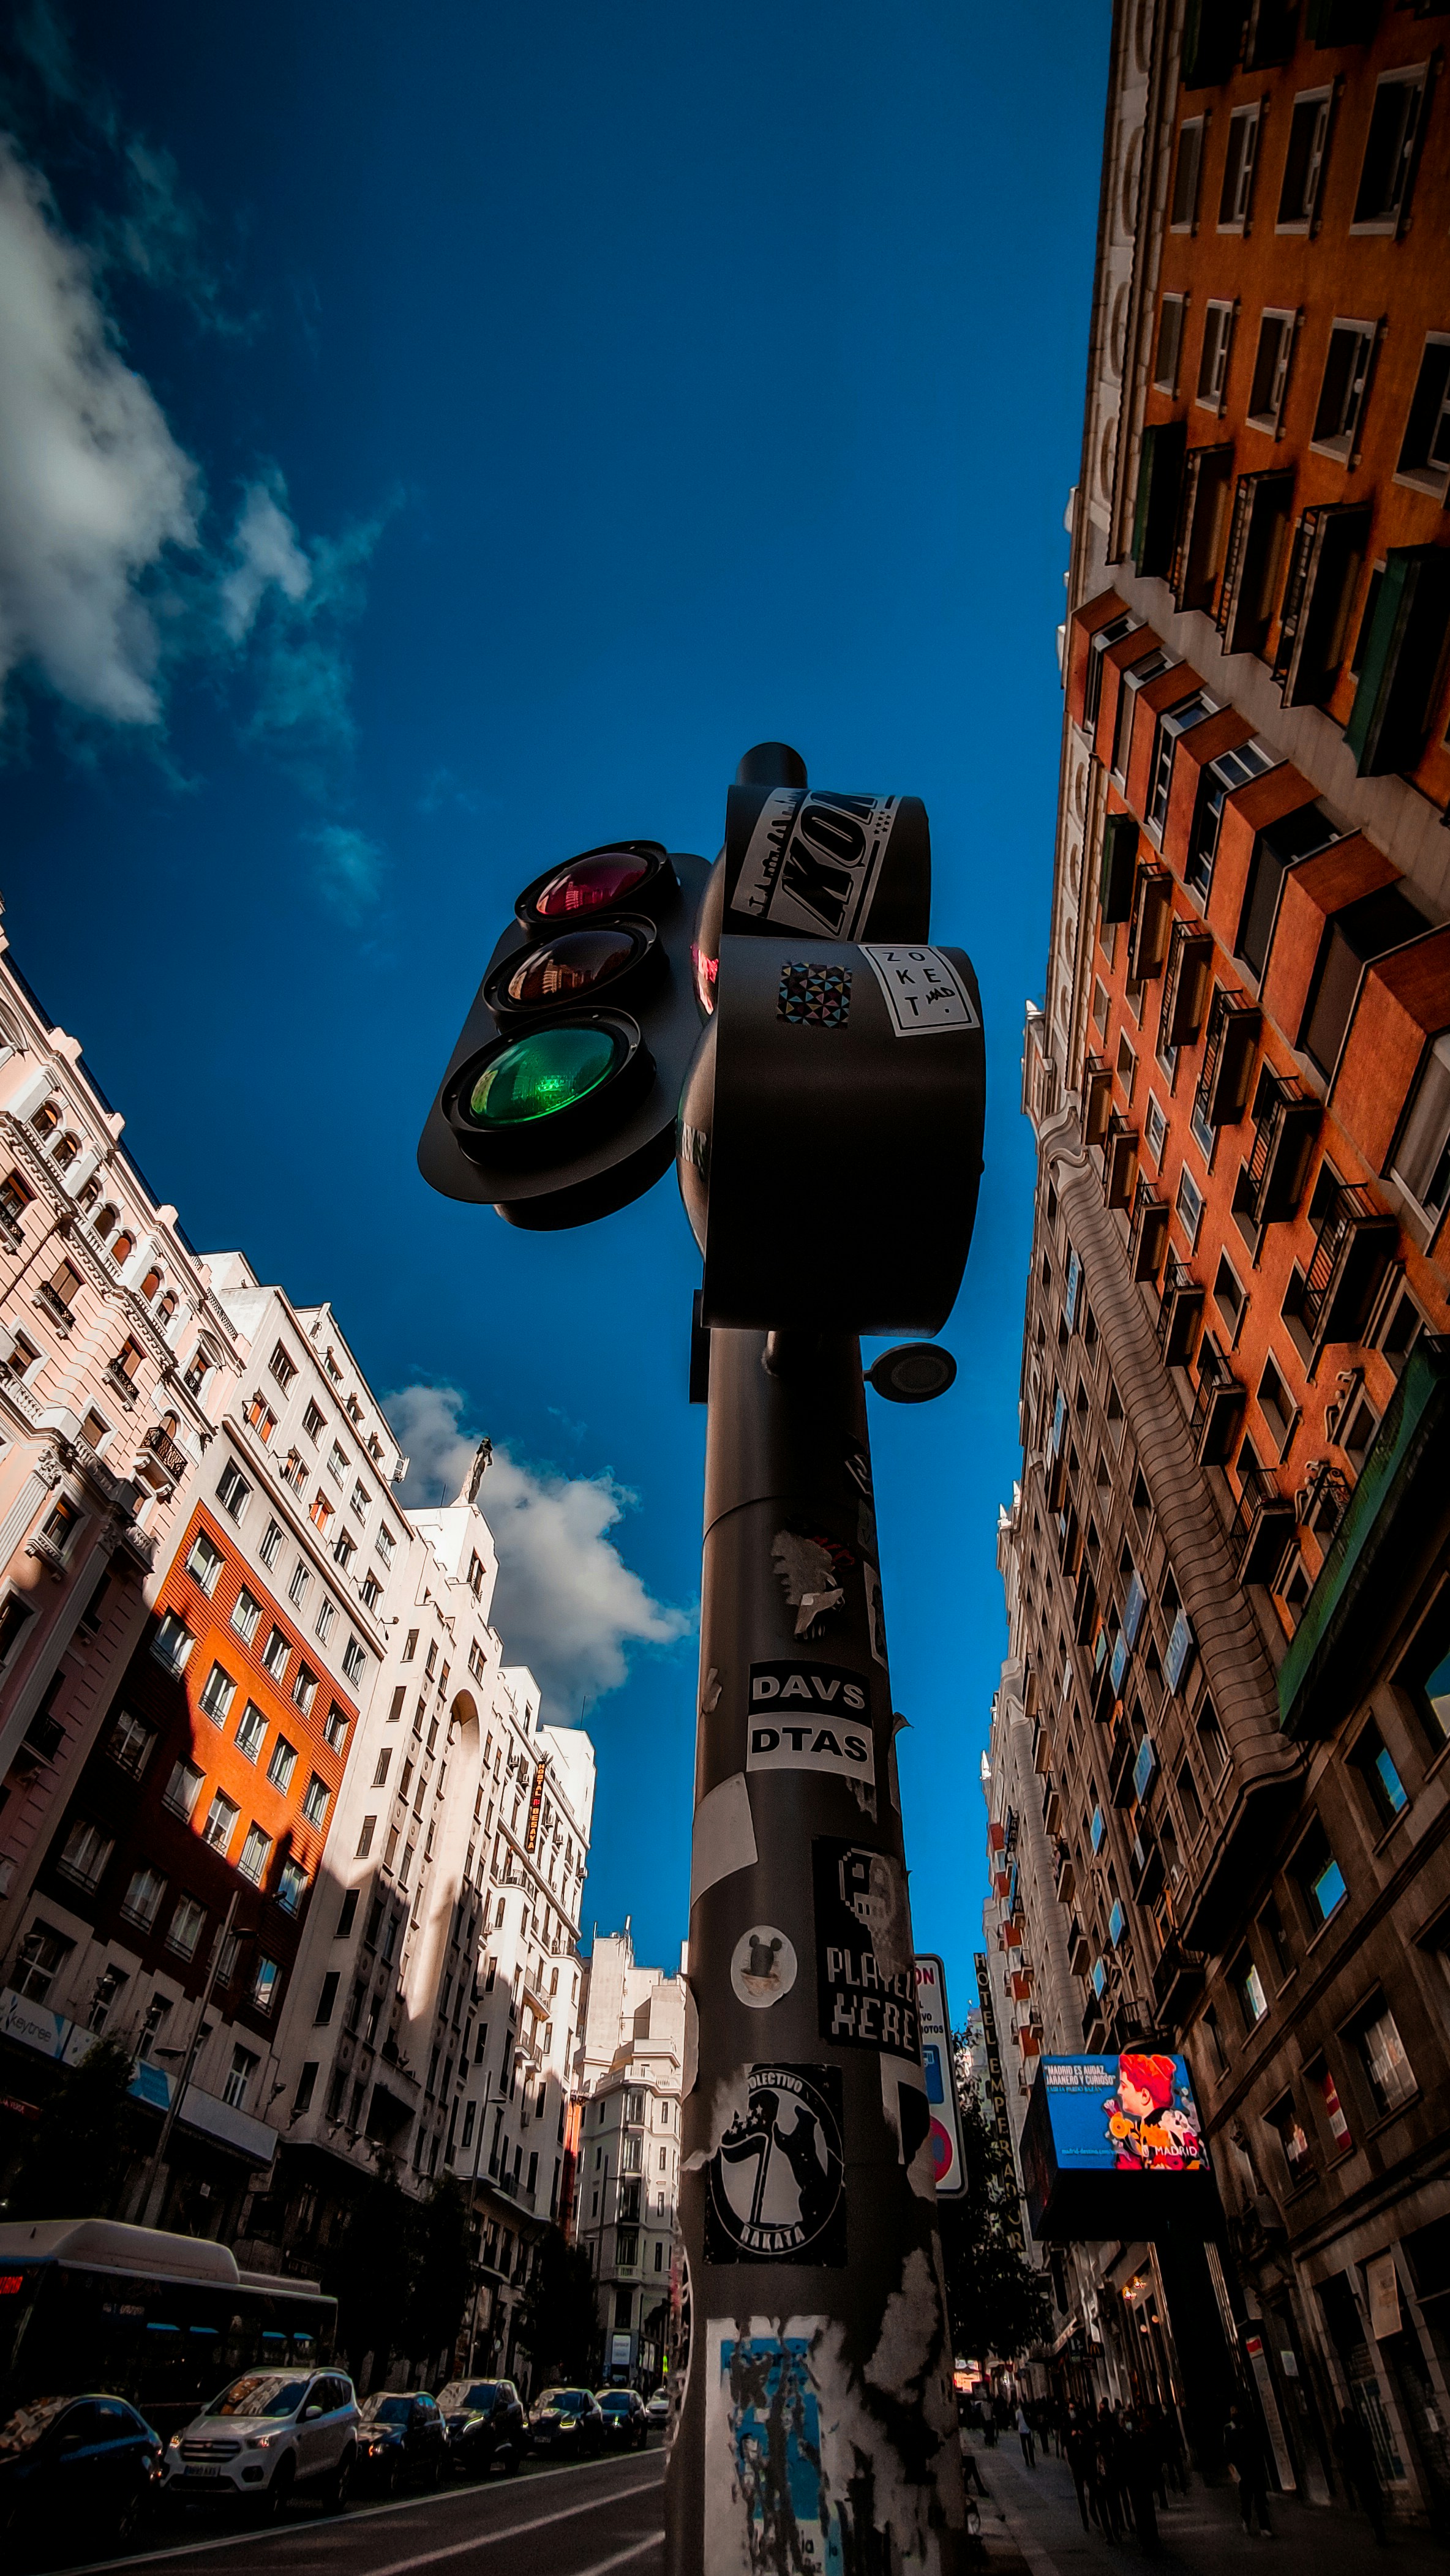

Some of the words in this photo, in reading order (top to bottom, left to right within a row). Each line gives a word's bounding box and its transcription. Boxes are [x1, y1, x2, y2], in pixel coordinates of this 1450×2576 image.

[753, 1675, 866, 1710] DAVS
[751, 1726, 868, 1763] DTAS
[10, 2010, 52, 2043] keytree
[831, 1992, 915, 2052] HERE
[748, 2072, 803, 2094] OLECTIVO
[1073, 2065, 1083, 2075] ES
[1083, 2065, 1107, 2076] AUDAZ,
[1079, 2075, 1084, 2086] Y
[974, 1953, 997, 2046] HOTEL
[989, 2057, 1026, 2252] EMPERADOR
[1154, 2145, 1198, 2159] MADRID
[740, 2224, 806, 2253] RAKATA
